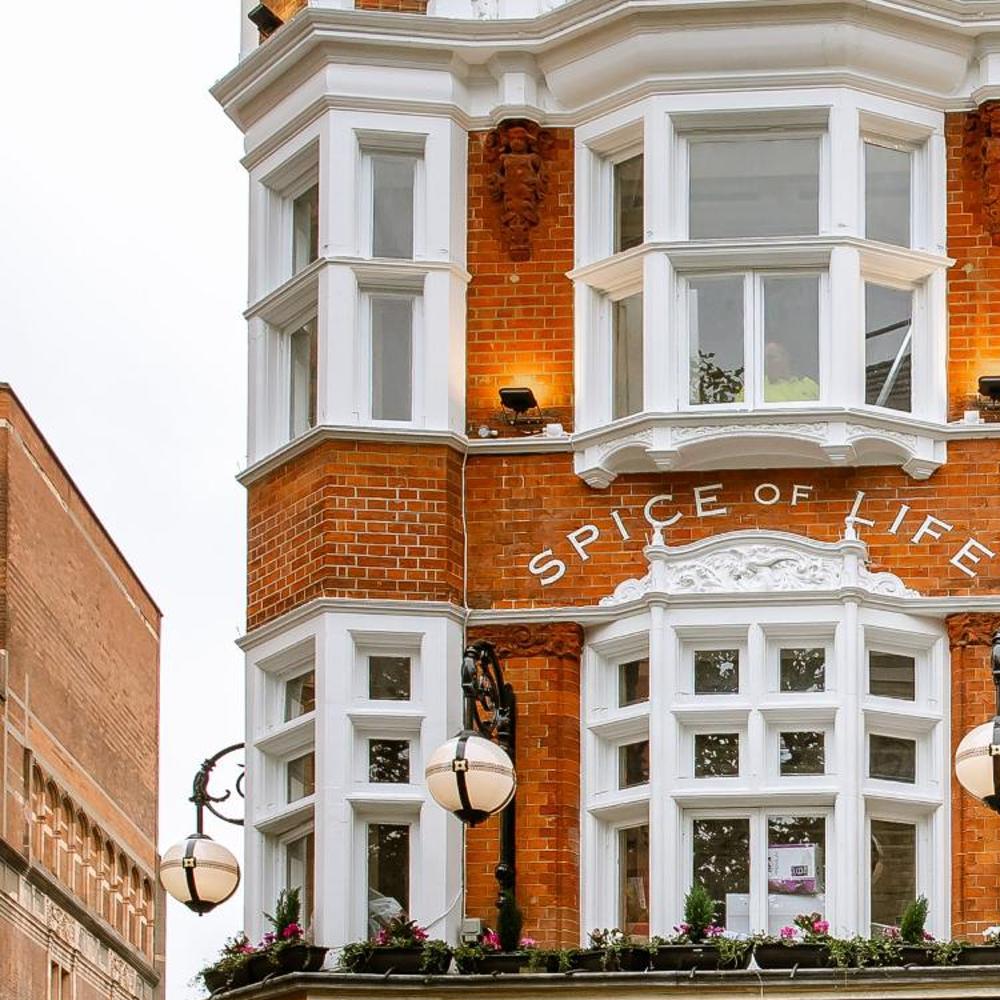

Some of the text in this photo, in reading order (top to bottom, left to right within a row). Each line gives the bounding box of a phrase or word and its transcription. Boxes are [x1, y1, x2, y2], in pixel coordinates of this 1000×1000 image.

[528, 483, 997, 586] SPICE OF LIFE
